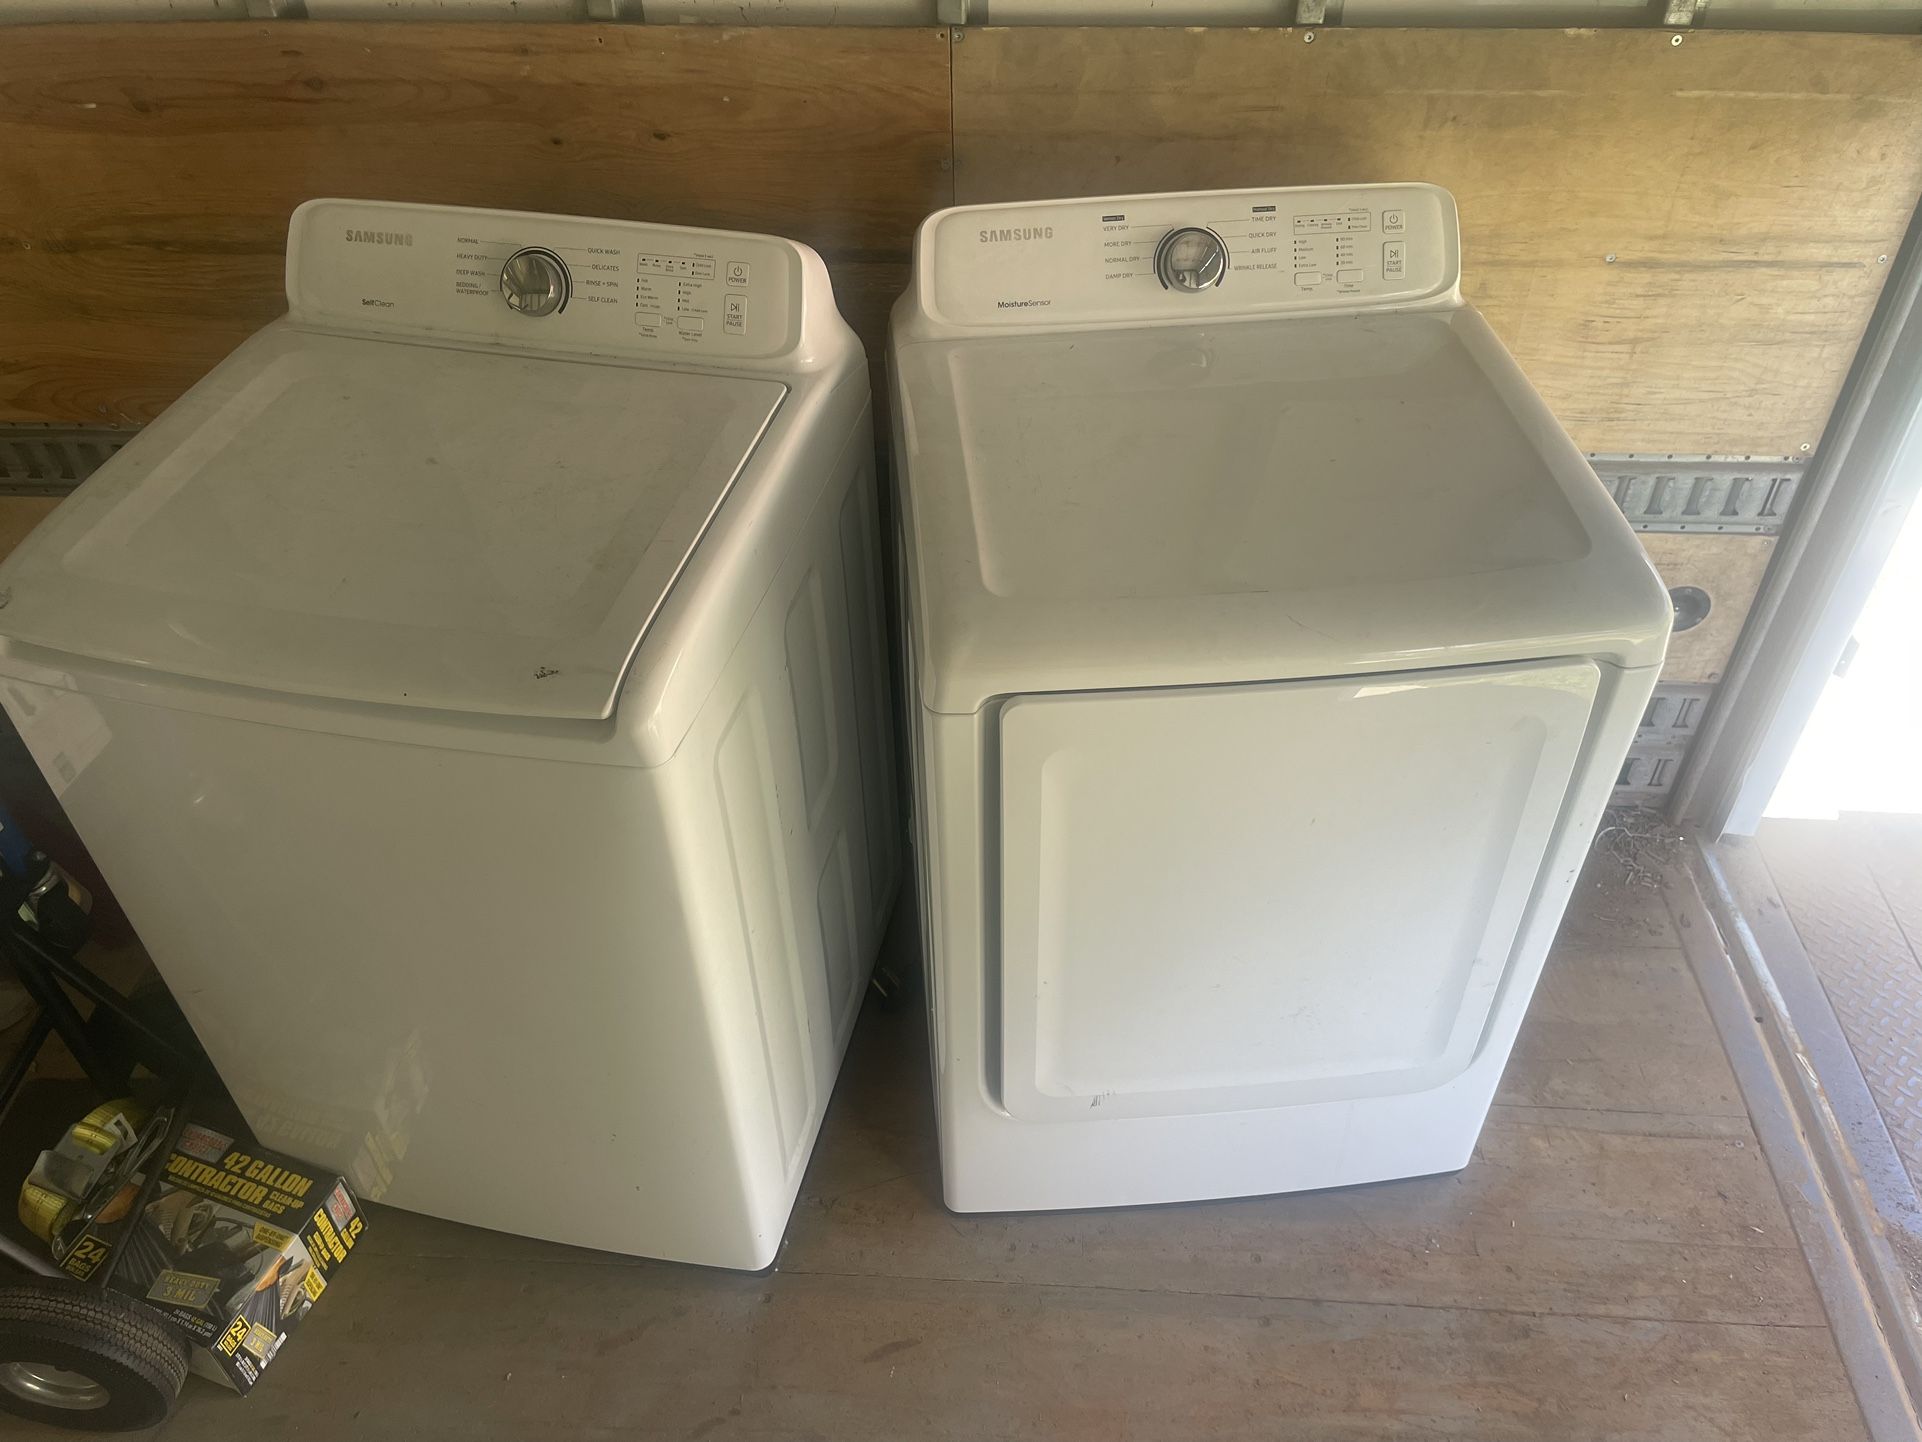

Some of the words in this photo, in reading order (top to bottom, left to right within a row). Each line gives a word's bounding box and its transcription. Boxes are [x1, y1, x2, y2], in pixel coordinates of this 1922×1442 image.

[345, 229, 413, 247] SAMSUNG
[979, 227, 1054, 243] SAMSUNG
[457, 237, 479, 245] NORMAL
[587, 247, 602, 255] QUICK
[603, 248, 621, 256] WASH
[456, 253, 473, 261] HEAVY
[591, 264, 620, 272] DELICATES
[1234, 264, 1256, 272] WRINKLE
[1256, 262, 1278, 271] RELEASE
[469, 270, 486, 278] WASH
[456, 281, 478, 289] BEDDING
[586, 279, 602, 287] RINSE
[727, 276, 747, 284] POWER
[456, 288, 489, 296] WATERPROOF
[587, 295, 600, 303] SELF
[600, 296, 618, 304] CLEAN
[997, 299, 1051, 309] MoistureSensor
[726, 313, 743, 321] START
[725, 320, 743, 328] PAUSE
[224, 1151, 251, 1173] 42
[244, 1160, 314, 1197] GALLON
[269, 1191, 305, 1210] CLEAN-UP
[262, 1200, 286, 1215] BAGS
[349, 1216, 363, 1240] 42
[313, 1208, 347, 1264] CONTRACTOR
[73, 1241, 107, 1264] 24
[68, 1257, 92, 1273] BAGS
[174, 1288, 197, 1301] MIL
[230, 1320, 247, 1342] 24
